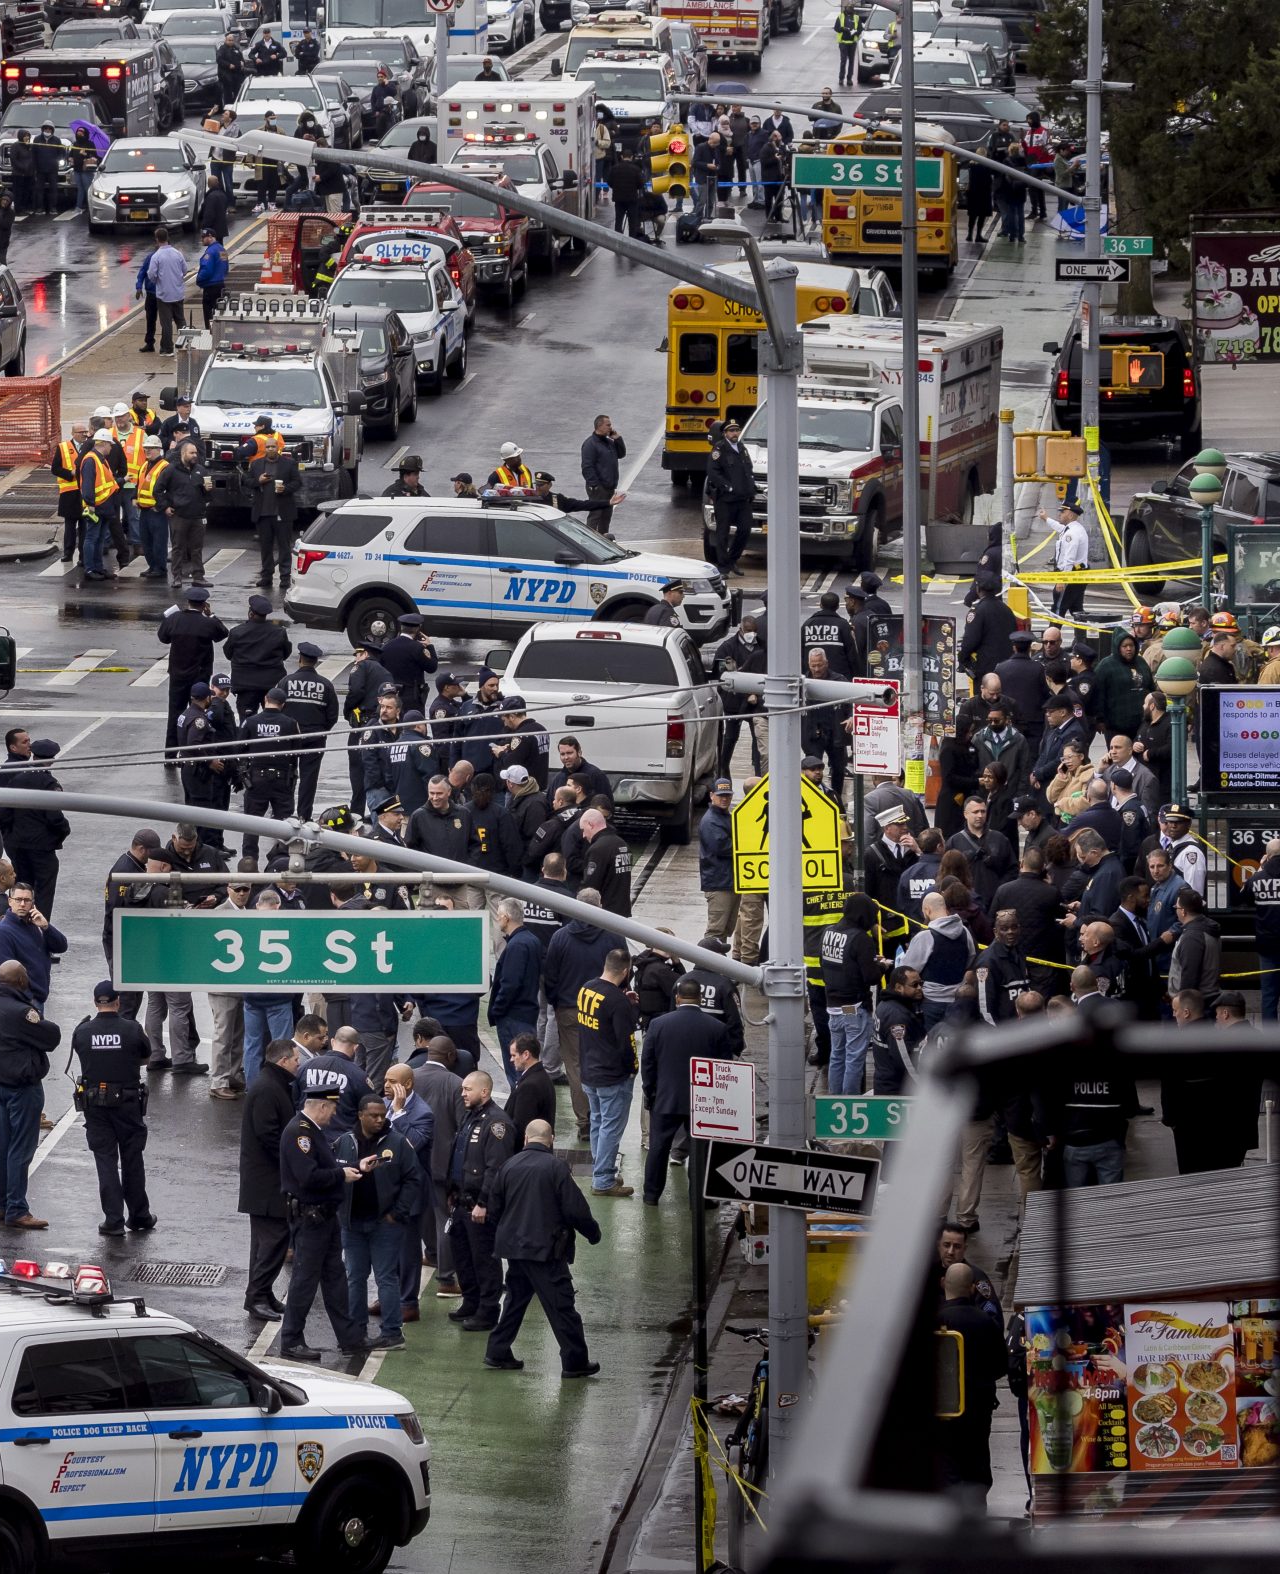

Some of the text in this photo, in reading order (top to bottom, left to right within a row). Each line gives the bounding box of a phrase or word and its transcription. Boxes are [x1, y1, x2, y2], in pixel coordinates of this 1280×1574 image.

[686, 1, 734, 9] AMBULANCE
[831, 163, 862, 183] 36
[1110, 239, 1145, 253] 36 ST
[1066, 265, 1119, 276] ONE WAY
[374, 553, 382, 561] 34
[628, 573, 658, 584] POLICE
[503, 577, 577, 604] NYPD
[804, 625, 839, 636] NYPD
[804, 634, 839, 642] POLICE
[287, 680, 325, 693] NYPD
[287, 690, 325, 702] POLICE
[1222, 701, 1234, 709] No
[871, 718, 884, 726] Truck
[1222, 711, 1268, 721] responds to
[256, 723, 281, 735] NYPD
[871, 725, 888, 734] Loading
[871, 731, 882, 739] Only
[1222, 731, 1239, 739] Use
[390, 744, 409, 754] NYPD
[857, 748, 888, 758] Except Sunday
[390, 753, 407, 763] TARU
[1222, 752, 1280, 762] Buses delayed
[1222, 763, 1259, 771] response
[1232, 830, 1255, 845] 36
[742, 859, 834, 881] SCOL
[806, 892, 834, 905] CHIEF OF
[821, 930, 848, 949] NYPD
[210, 928, 394, 974] 35 St
[821, 943, 844, 961] POLICE
[576, 986, 606, 1016] ATF
[91, 1034, 122, 1047] NYPD
[715, 1063, 731, 1074] Truck
[306, 1068, 348, 1091] NYPD
[715, 1072, 739, 1086] Loading
[715, 1081, 729, 1093] Only
[1074, 1081, 1110, 1096] POLICE
[695, 1094, 725, 1107] 7am 7pm
[695, 1103, 738, 1119] Except Sunday
[829, 1102, 869, 1135] 35
[733, 1161, 856, 1196] ONE WAY
[1134, 1317, 1220, 1341] La Familia
[1137, 1355, 1156, 1364] BAR
[1082, 1389, 1121, 1403] 4-8pm
[1107, 1402, 1124, 1411] Beers
[348, 1416, 386, 1430] POLICE
[1098, 1419, 1125, 1427] Cocktails
[52, 1424, 148, 1438] POLICE DOG KEEP BACK
[1102, 1434, 1125, 1444] Sangria
[63, 1451, 106, 1466] COURTESY
[1109, 1451, 1126, 1459] Shots
[56, 1465, 128, 1479] PROFESSIONALISM
[173, 1441, 279, 1493] NYPD
[50, 1480, 86, 1494] RESPECT
